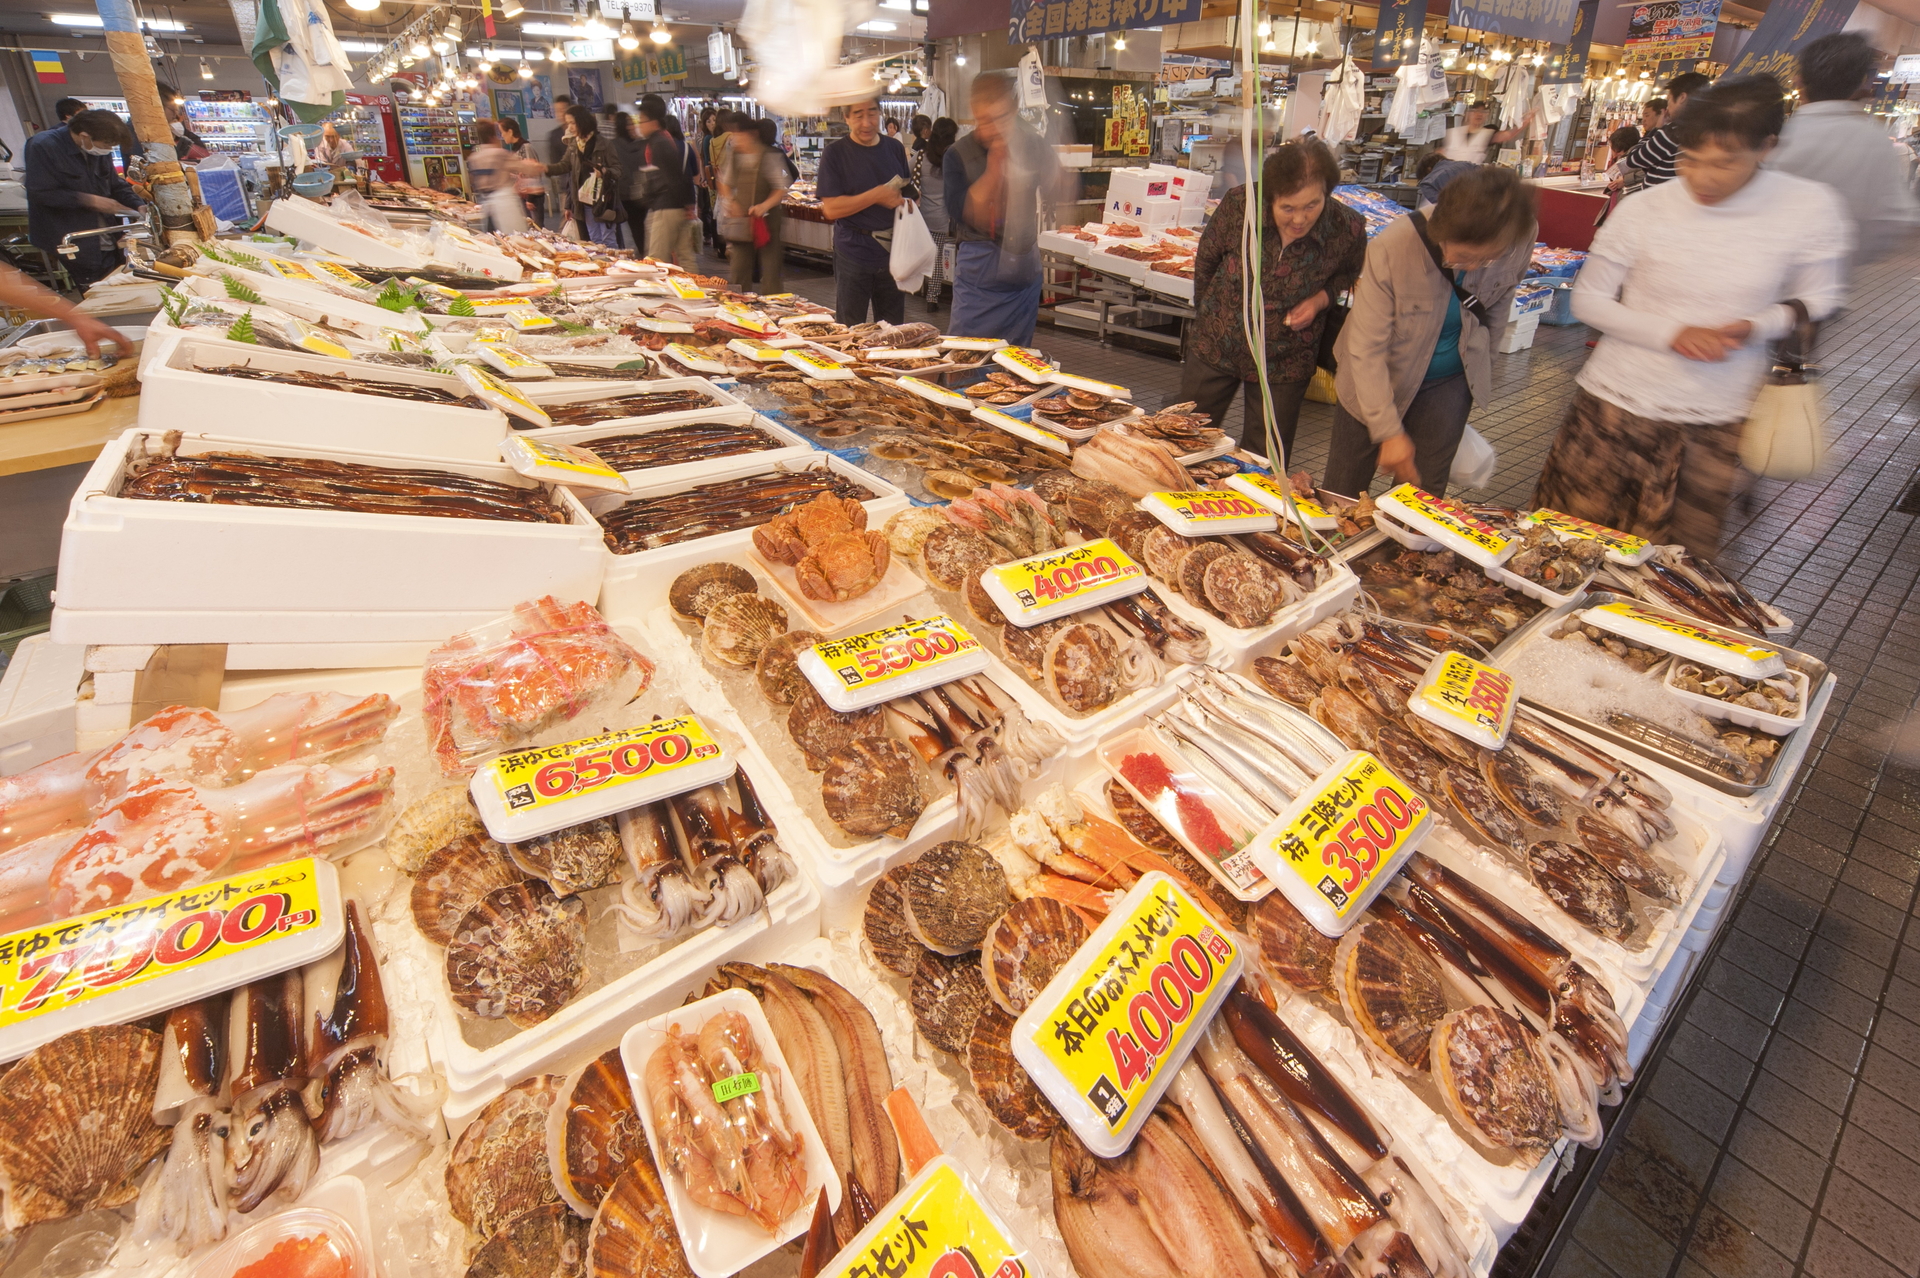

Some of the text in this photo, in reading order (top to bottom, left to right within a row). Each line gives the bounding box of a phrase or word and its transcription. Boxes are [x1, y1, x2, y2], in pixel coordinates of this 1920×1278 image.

[1026, 0, 1188, 37] 全国発送承り中
[1190, 499, 1271, 519] 4,000円
[1417, 503, 1498, 549] 活サザエ
[1033, 556, 1138, 601] 4,000円
[856, 631, 978, 678] 5,000円
[534, 733, 720, 798] 6,500円
[1322, 786, 1426, 894] 3,500円
[1322, 879, 1347, 909] 税込
[16, 891, 317, 1013] 7,000円
[1054, 895, 1180, 1057] 本日のおススメセット
[1106, 934, 1233, 1091] 4,000円
